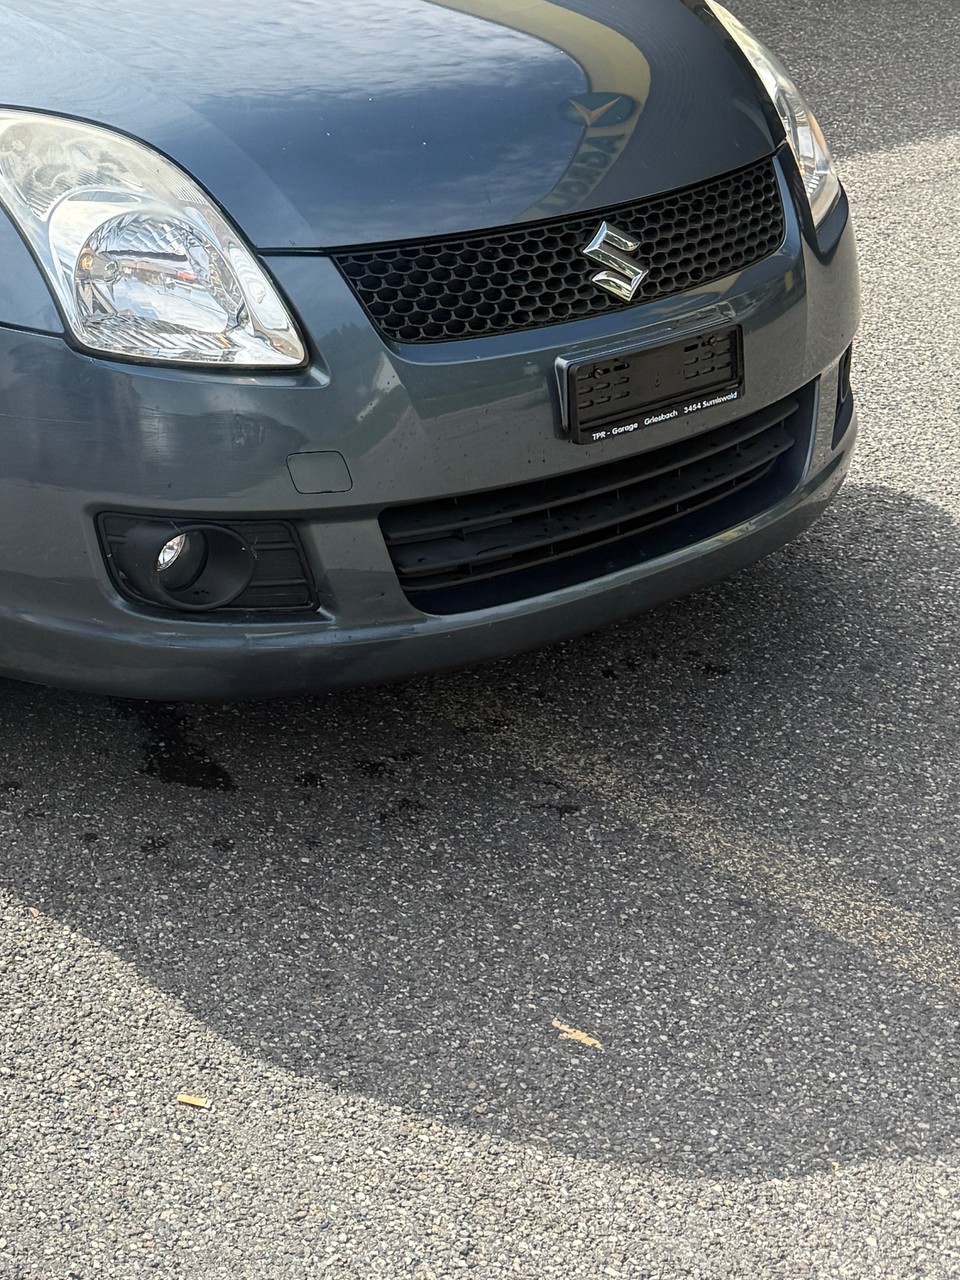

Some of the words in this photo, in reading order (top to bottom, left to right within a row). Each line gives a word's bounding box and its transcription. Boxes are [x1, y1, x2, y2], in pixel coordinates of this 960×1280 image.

[592, 431, 606, 441] TPR
[612, 422, 639, 435] Garage
[644, 410, 678, 426] Griesbach
[684, 403, 702, 414] 3454
